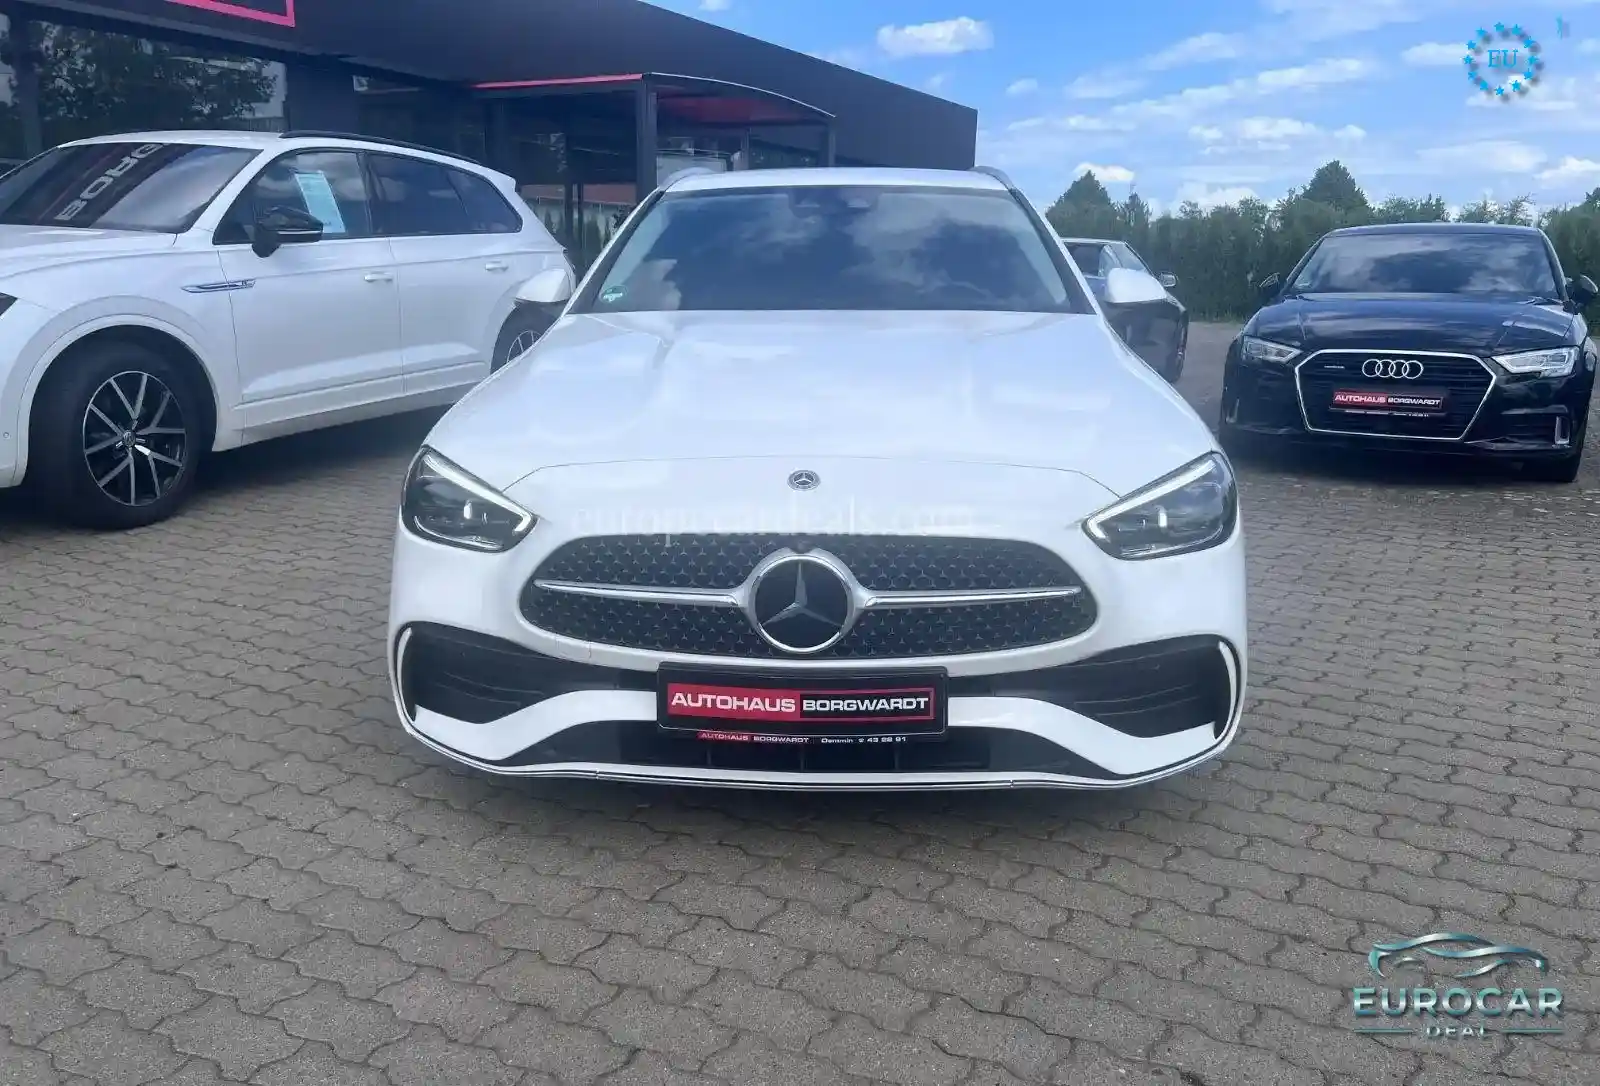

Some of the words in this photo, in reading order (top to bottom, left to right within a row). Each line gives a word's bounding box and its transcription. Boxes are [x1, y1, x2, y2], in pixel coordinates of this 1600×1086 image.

[1334, 394, 1386, 404] AUTOHAUS
[1387, 396, 1441, 405] BORGWARDT
[671, 692, 796, 713] AUTOHAUS
[802, 697, 929, 712] BORGWARDT
[701, 732, 749, 741] AUTOHAUS
[753, 735, 809, 743] BORGWARDT
